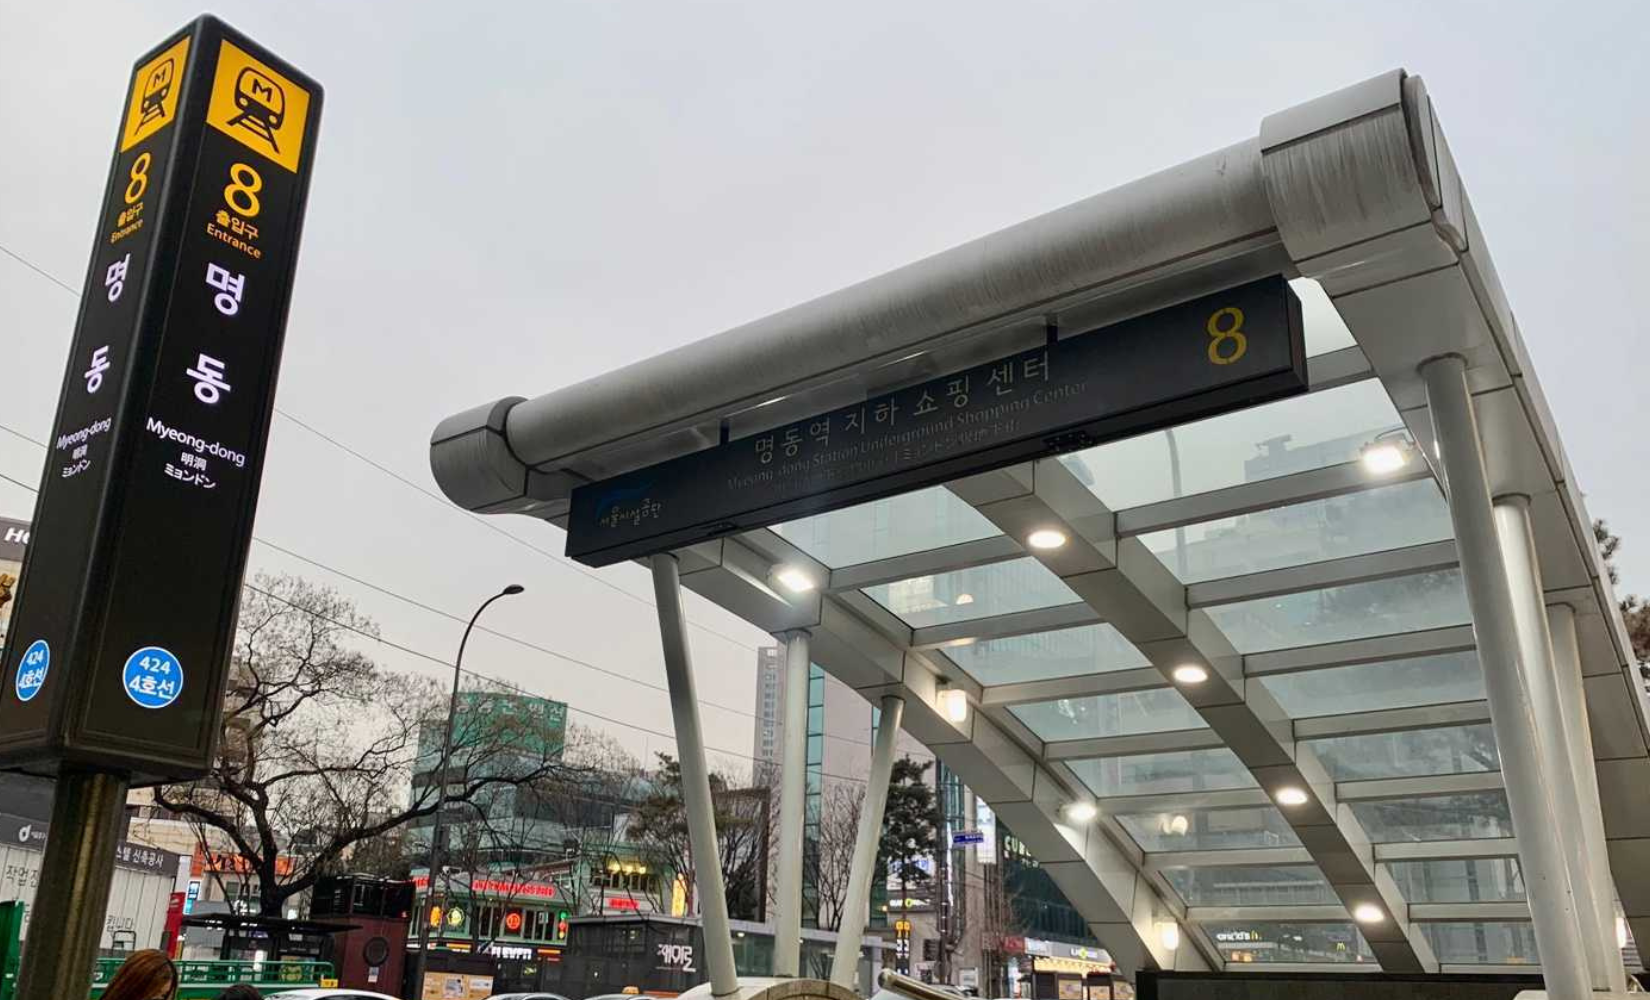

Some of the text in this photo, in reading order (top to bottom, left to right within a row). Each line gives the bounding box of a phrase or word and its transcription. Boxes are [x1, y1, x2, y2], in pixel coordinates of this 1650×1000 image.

[251, 78, 273, 103] M
[124, 152, 151, 204] 8
[223, 162, 263, 217] 8
[110, 219, 144, 244] Entrance
[216, 209, 259, 240] 출입구
[206, 222, 262, 260] Entrance
[1207, 307, 1247, 365] 8
[755, 350, 1049, 464] 명동역 지하 쇼핑 센터
[56, 416, 112, 450] Myeong-dong
[145, 416, 246, 468] Myeong-dong
[163, 462, 217, 489] ミョンドン
[180, 452, 207, 472] 明洞
[26, 650, 45, 666] 424
[139, 655, 171, 675] 424
[18, 667, 45, 690] 4호선
[129, 675, 175, 700] 4호선
